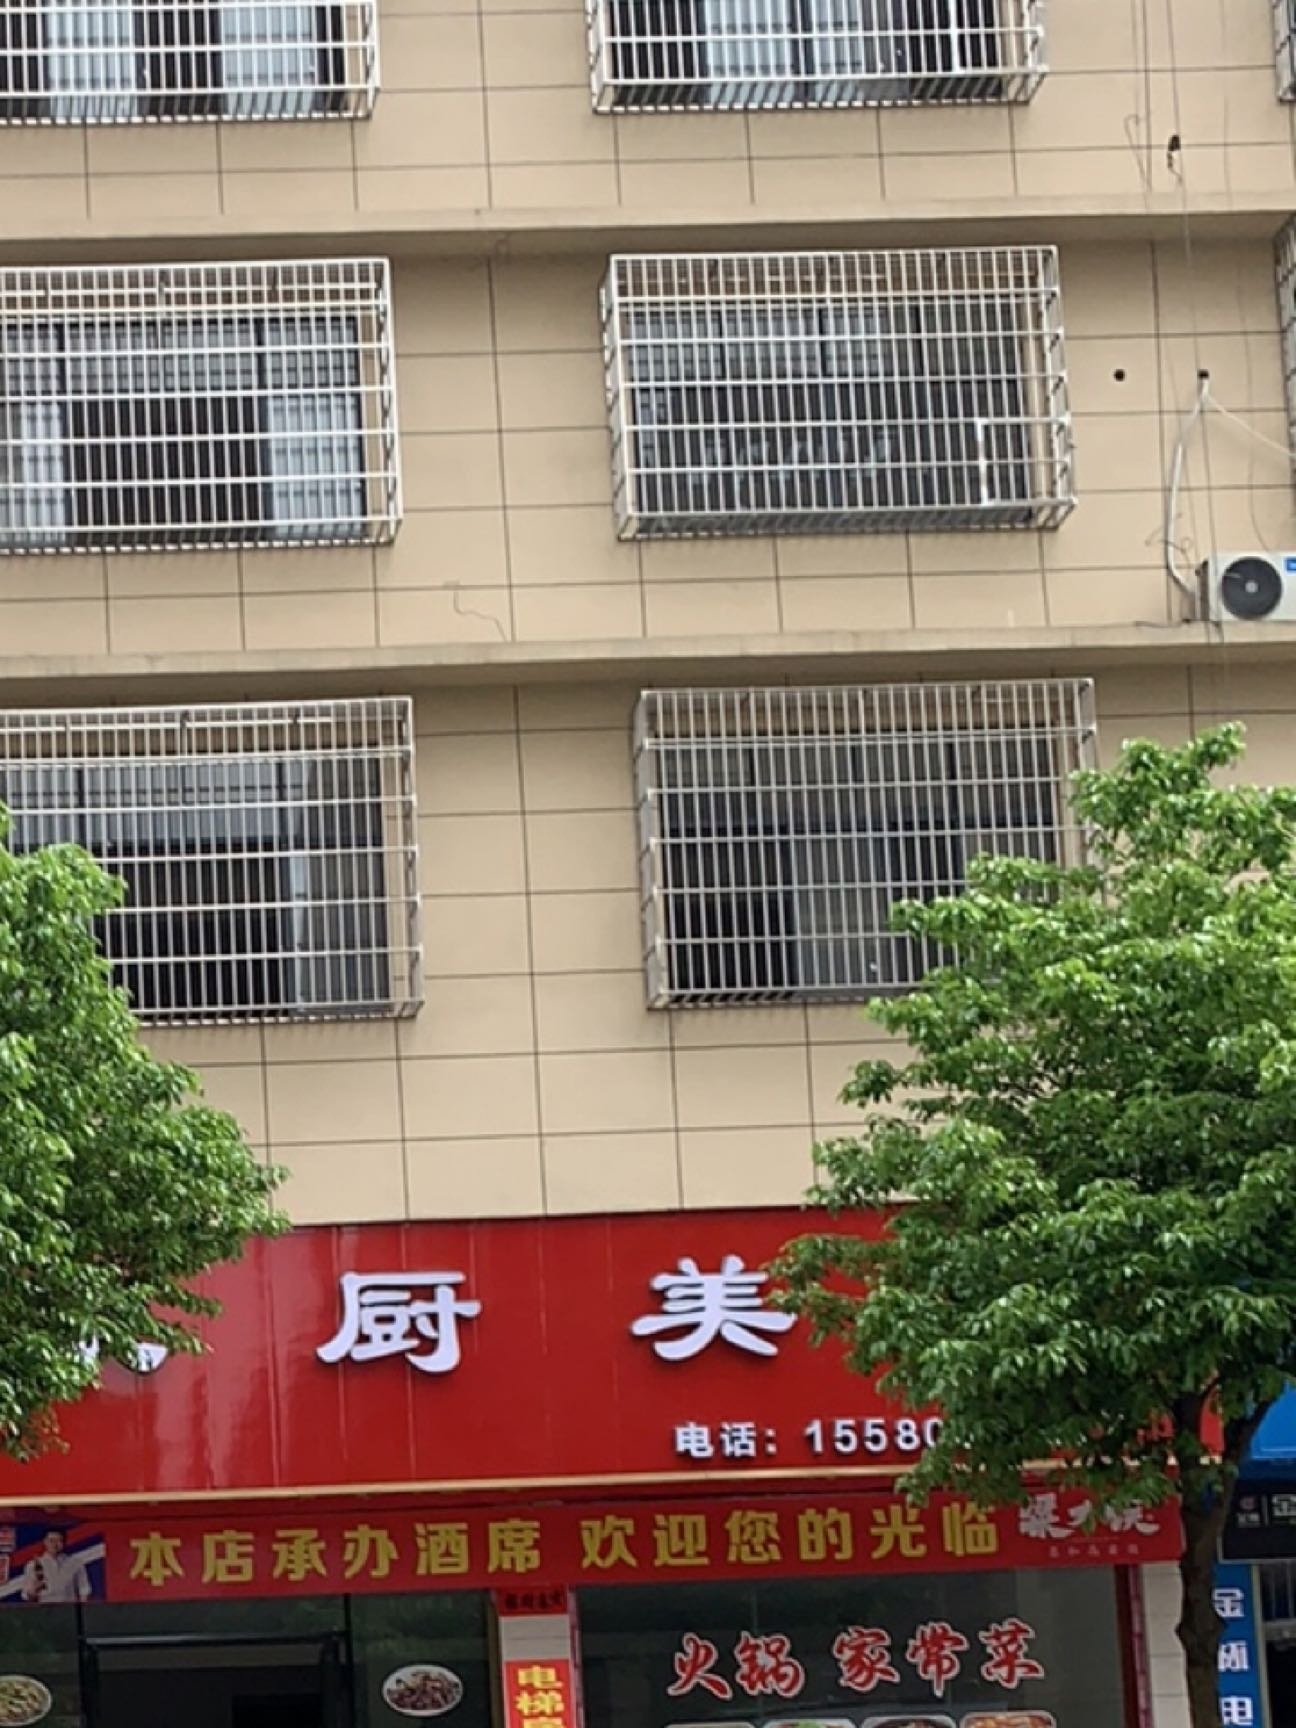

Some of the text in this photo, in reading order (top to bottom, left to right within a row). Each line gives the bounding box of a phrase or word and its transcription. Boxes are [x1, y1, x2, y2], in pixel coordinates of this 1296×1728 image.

[129, 1503, 999, 1586] 本店承办酒席 欢迎您的光临
